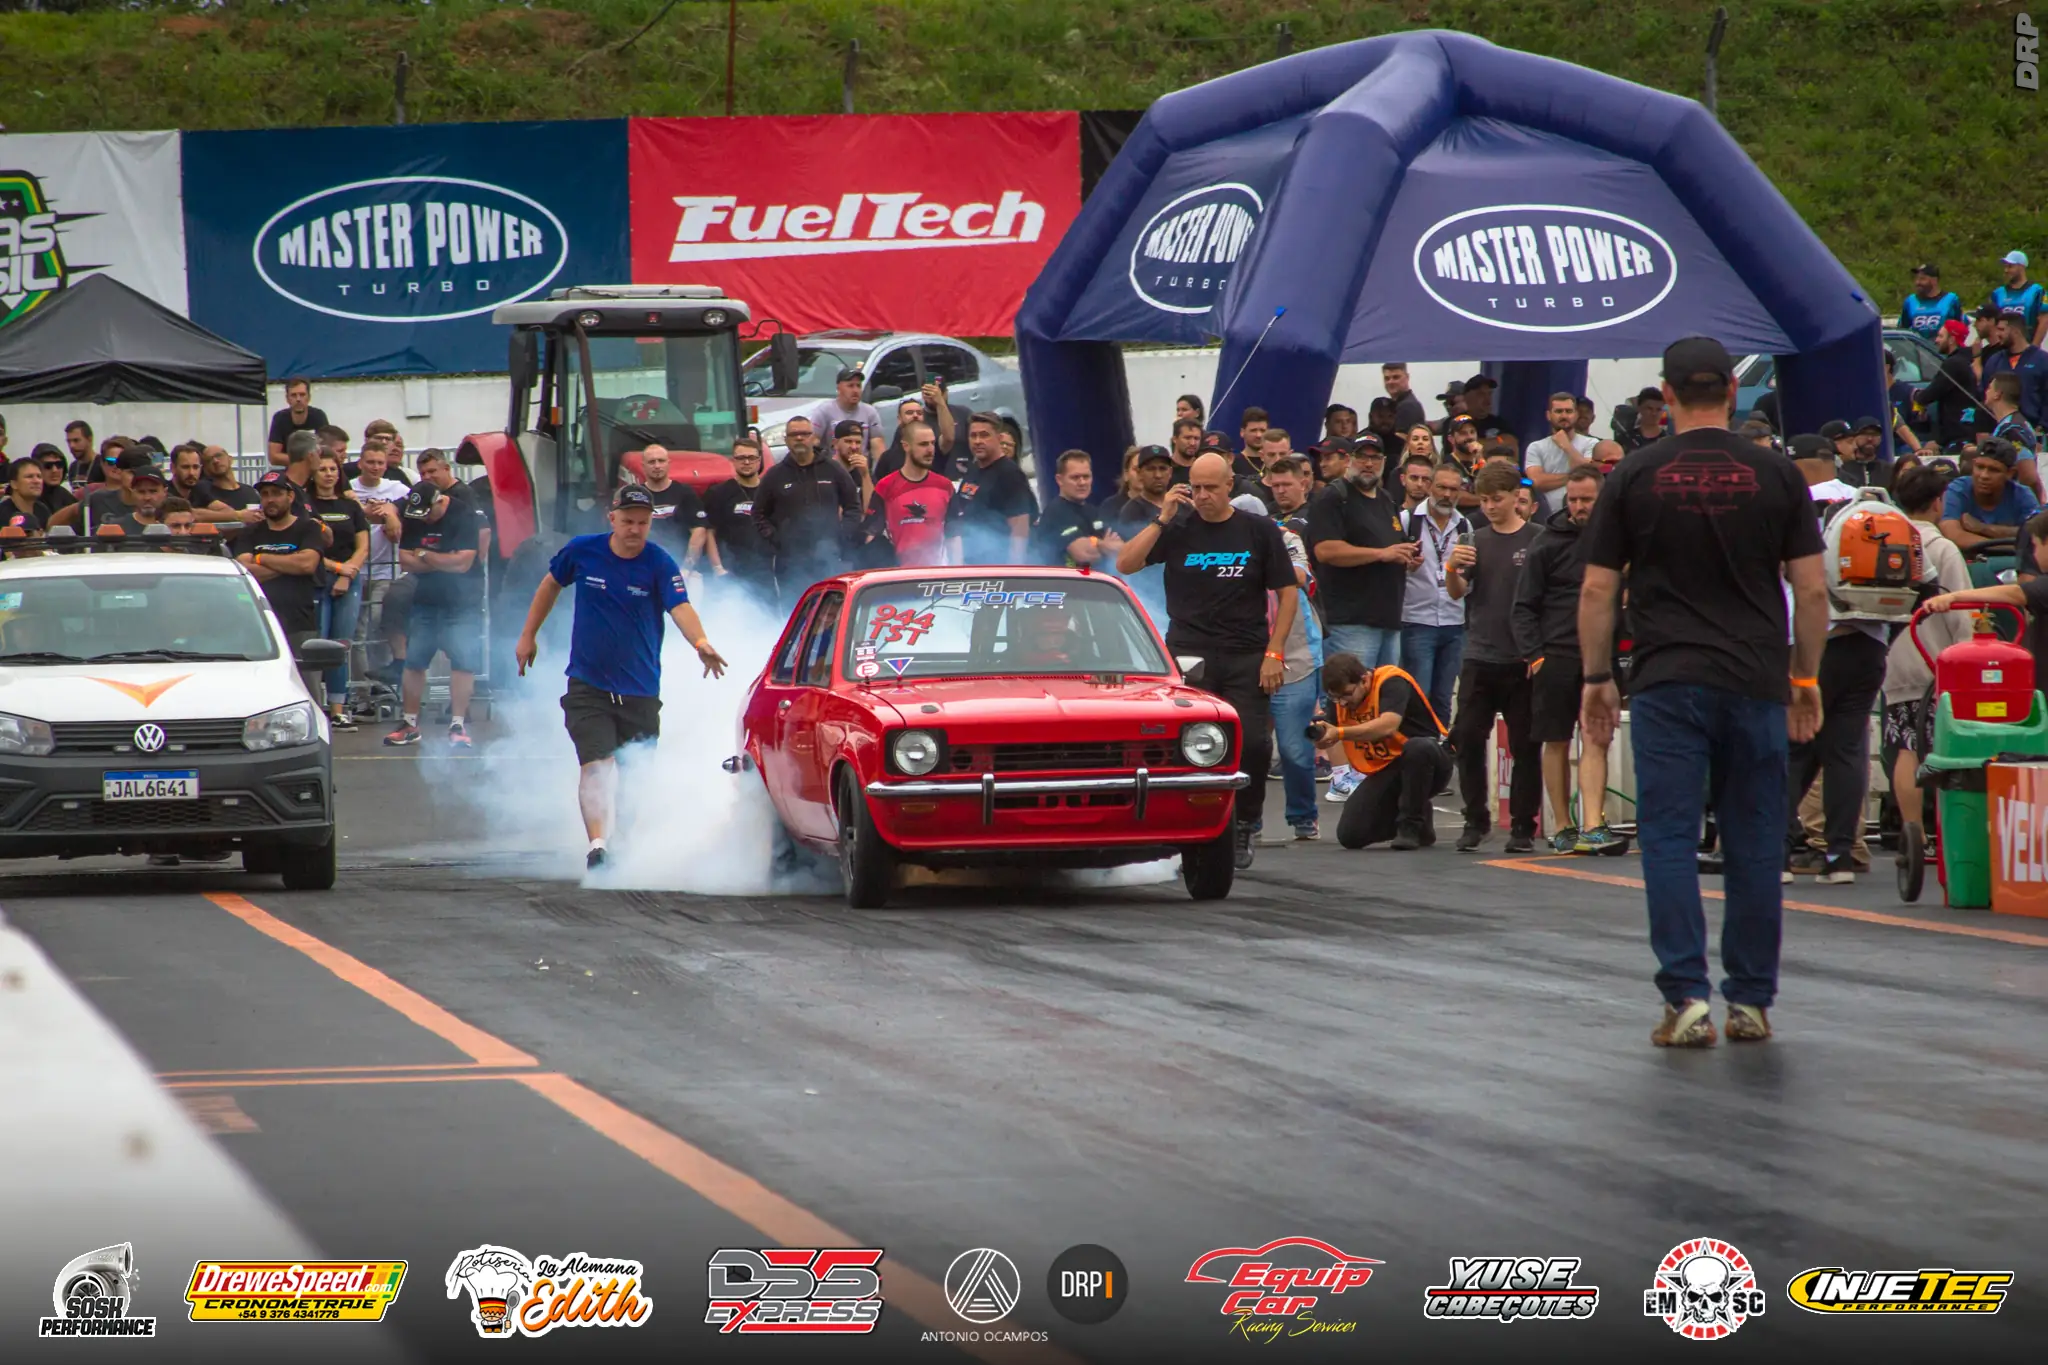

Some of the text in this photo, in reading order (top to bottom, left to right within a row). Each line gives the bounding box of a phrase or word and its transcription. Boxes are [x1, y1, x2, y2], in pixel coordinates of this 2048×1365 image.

[673, 190, 1045, 243] FuelTech
[279, 202, 543, 269] MASTER POWER
[1144, 203, 1218, 263] MASTER
[1433, 226, 1654, 285] MASTER POWER
[338, 279, 490, 296] TURBO
[1487, 296, 1615, 309] TURBO
[1184, 550, 1252, 571] expert
[1216, 566, 1245, 578] 2JZ
[918, 581, 1004, 597] TECH
[875, 604, 936, 629] 944
[869, 620, 929, 646] TST
[112, 780, 188, 798] JAL6G41
